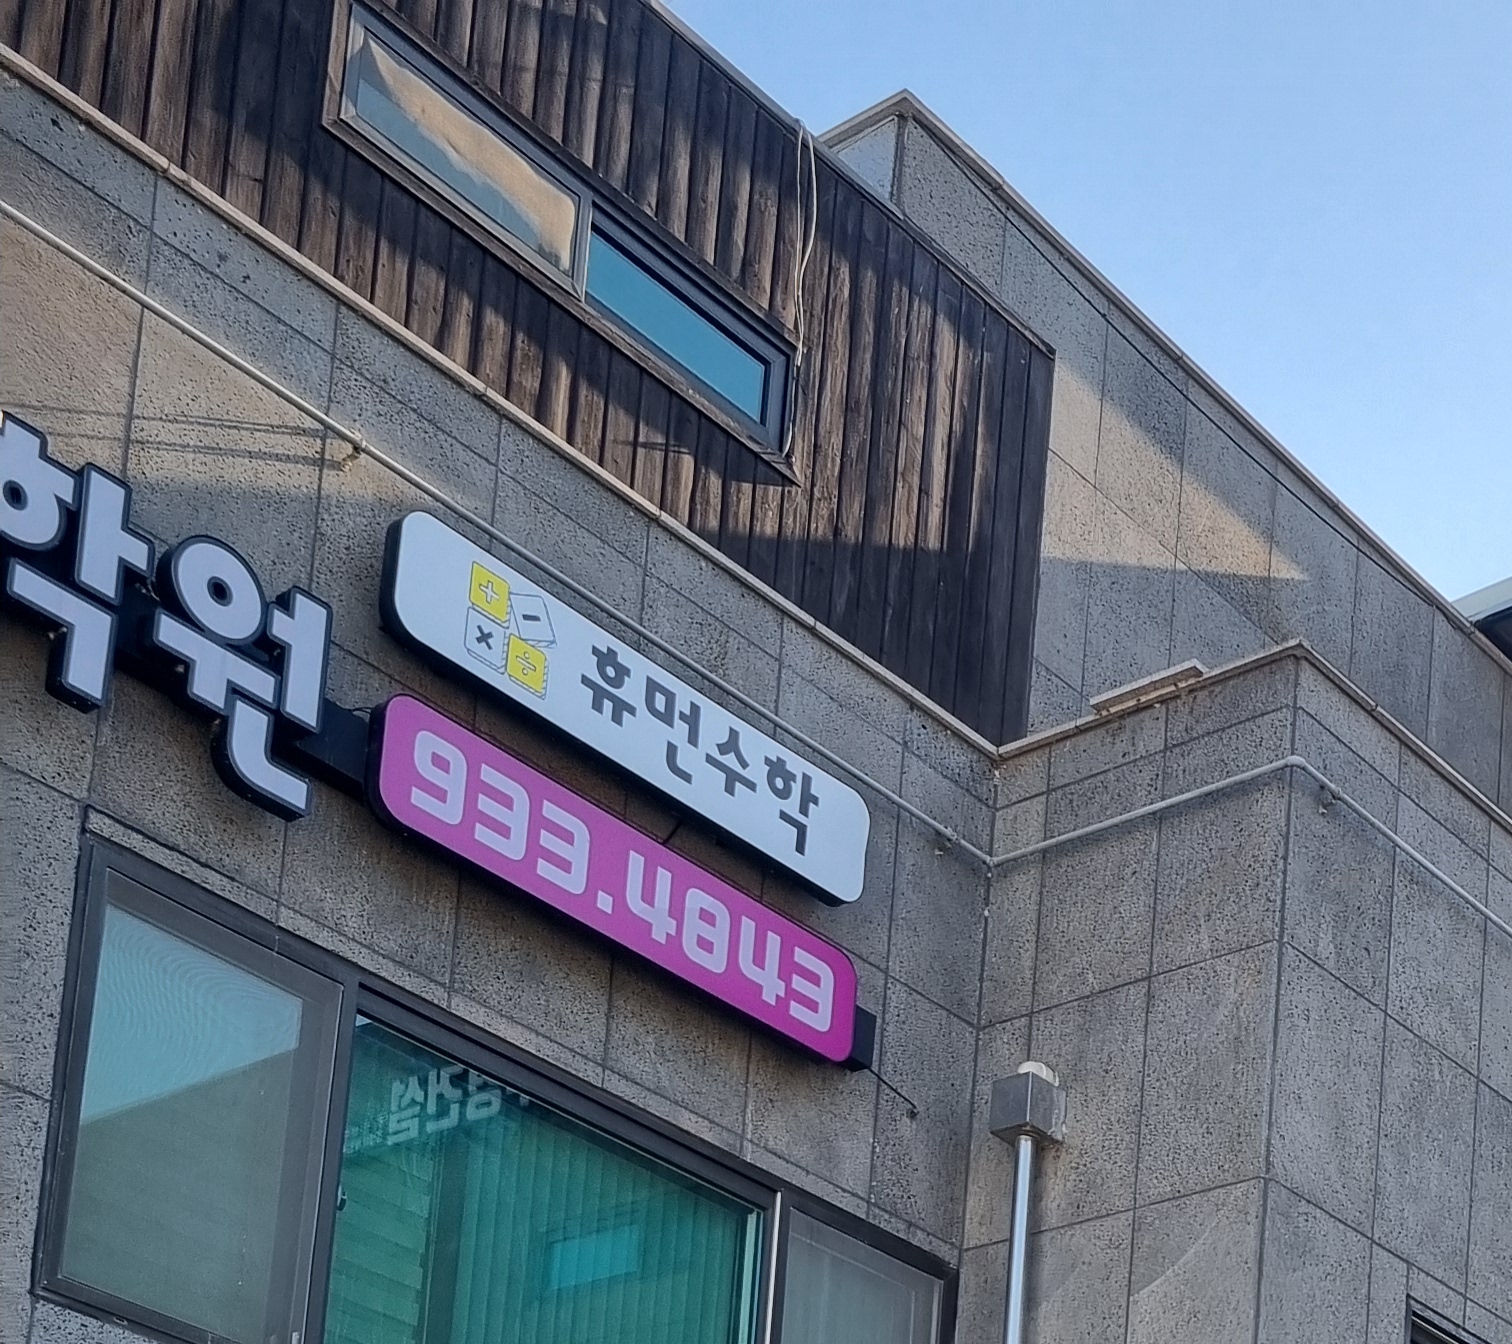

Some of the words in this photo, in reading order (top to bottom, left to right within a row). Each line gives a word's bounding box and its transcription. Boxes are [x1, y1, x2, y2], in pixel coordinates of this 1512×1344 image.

[0, 416, 326, 815] 학원
[579, 642, 820, 857] 휴먼수학
[410, 729, 837, 1035] 933.4843
